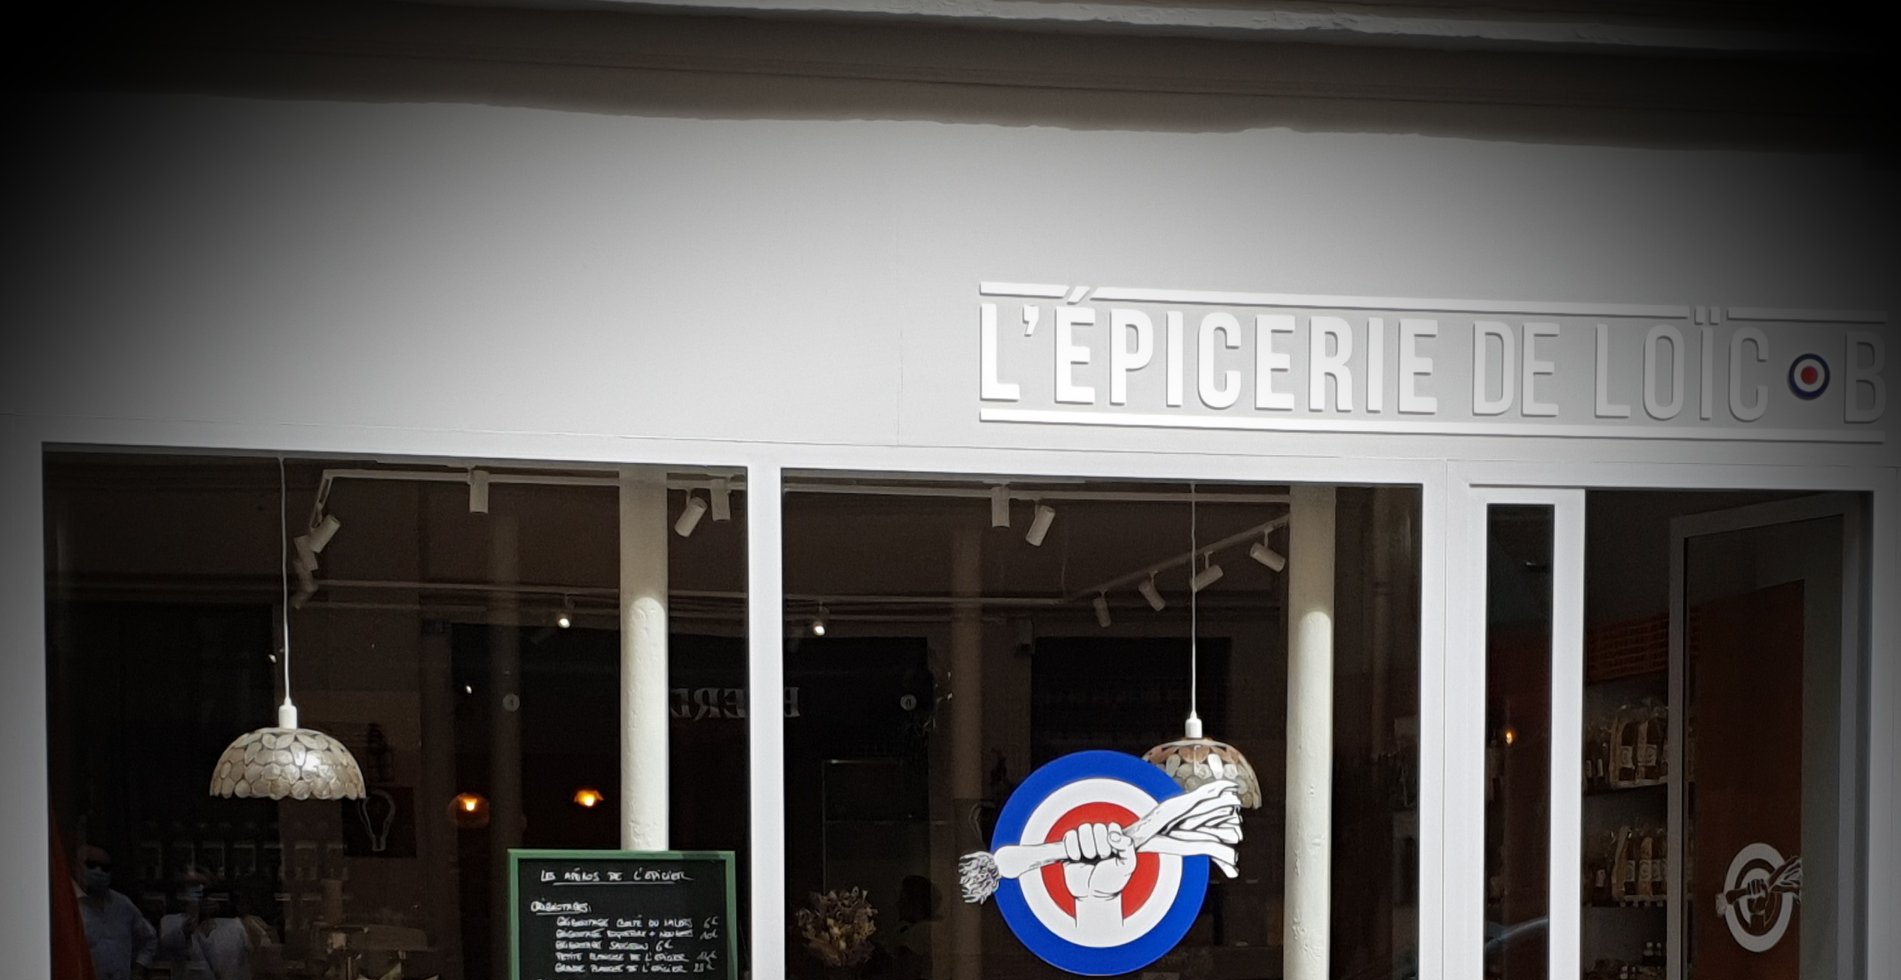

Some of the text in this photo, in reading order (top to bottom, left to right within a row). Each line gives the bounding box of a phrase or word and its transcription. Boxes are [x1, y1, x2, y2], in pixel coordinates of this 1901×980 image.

[979, 285, 1889, 425] L'ÉPICERIE DE LOÏC B
[540, 869, 556, 882] LES
[607, 871, 623, 881] DE
